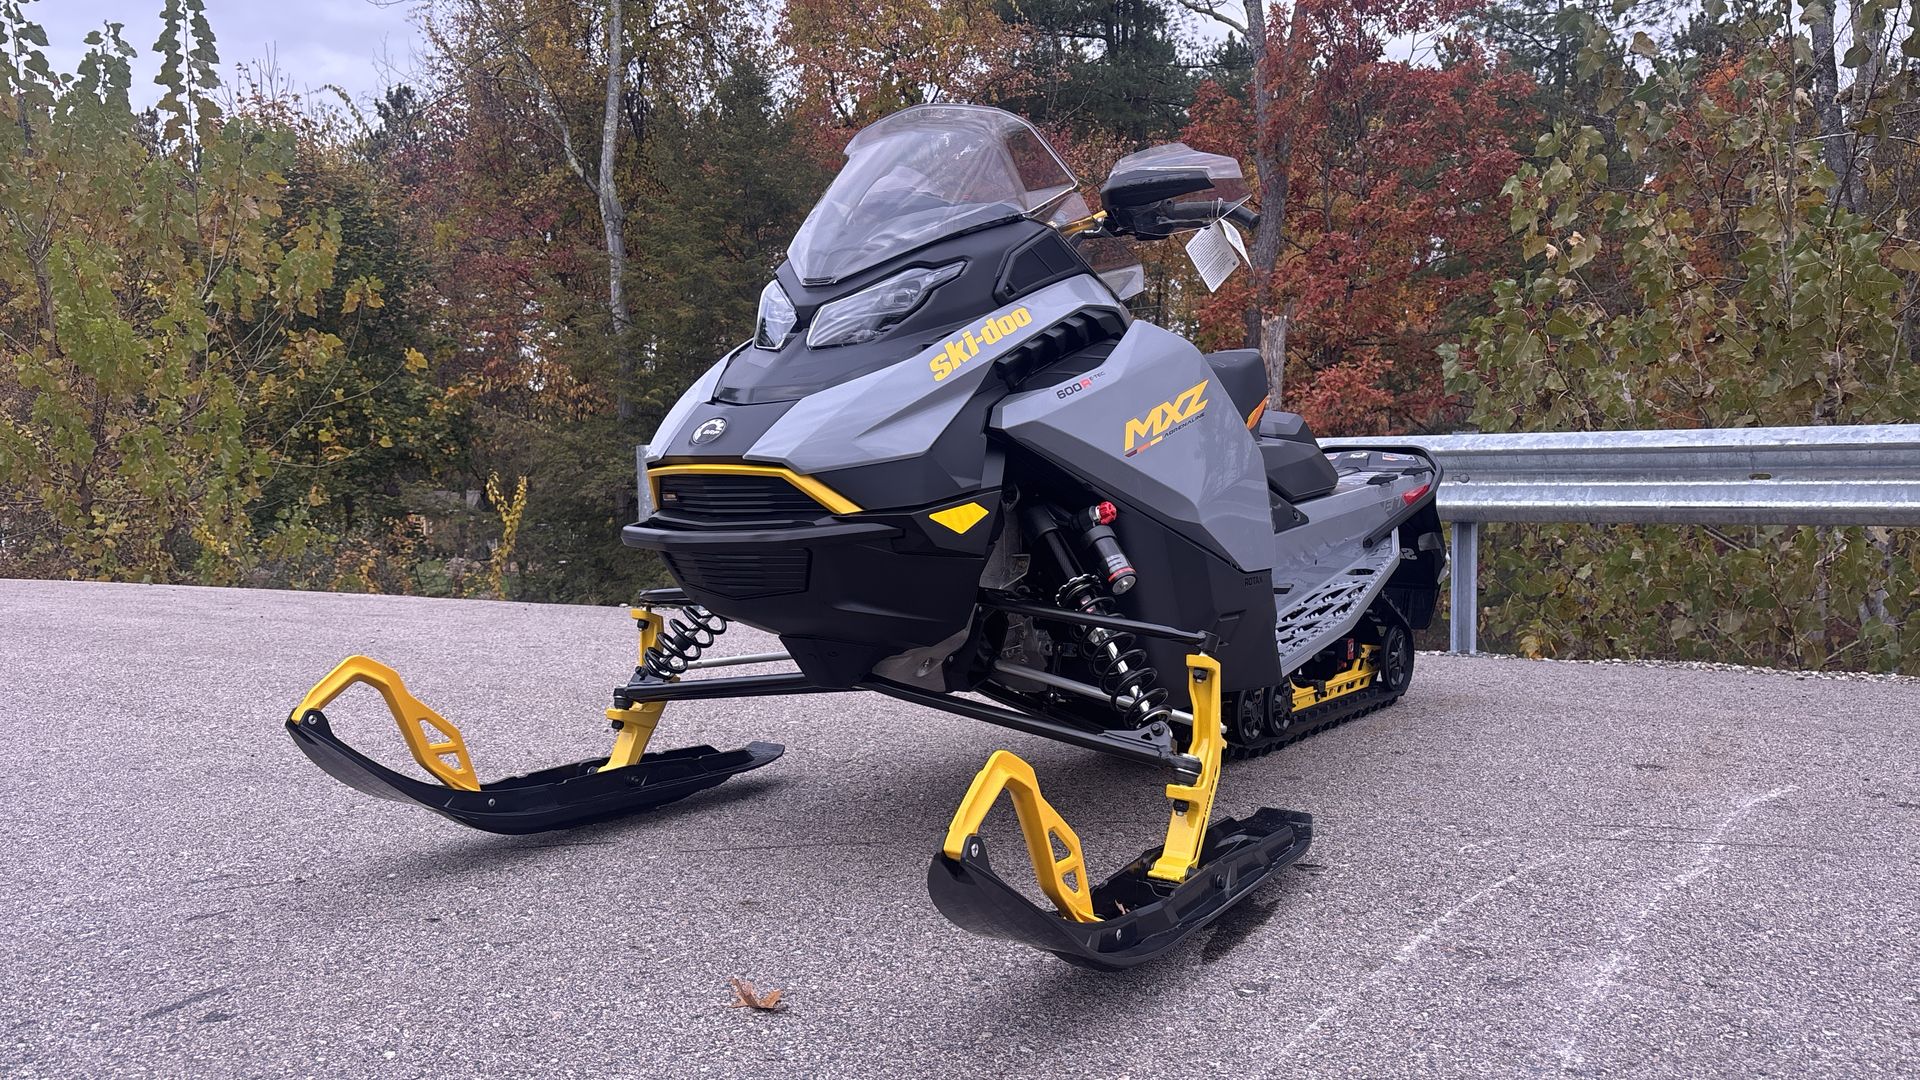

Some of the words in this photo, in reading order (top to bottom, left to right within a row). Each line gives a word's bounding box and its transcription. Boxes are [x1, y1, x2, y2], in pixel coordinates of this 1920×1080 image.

[929, 307, 1032, 381] ski-doo
[1124, 379, 1208, 451] MXZ
[1163, 412, 1205, 438] ADRENALINE
